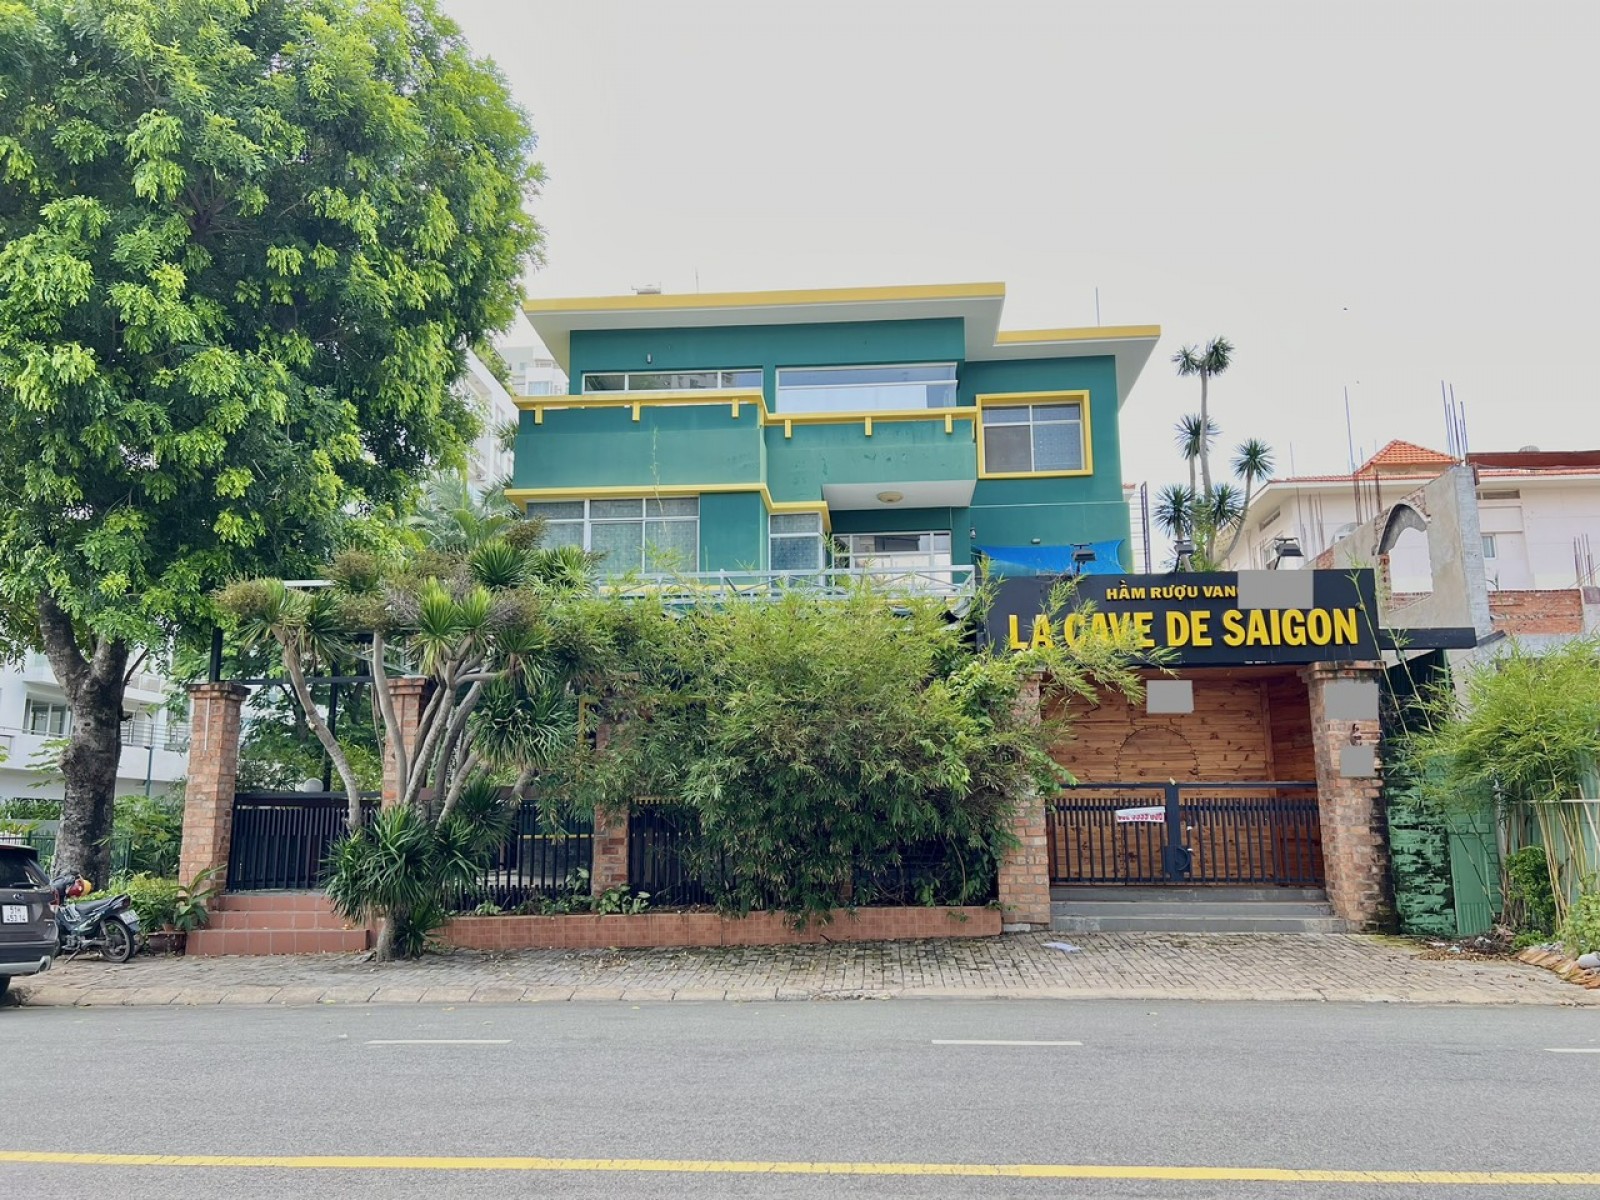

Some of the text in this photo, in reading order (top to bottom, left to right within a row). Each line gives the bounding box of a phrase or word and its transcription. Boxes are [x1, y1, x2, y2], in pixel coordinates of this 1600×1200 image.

[1106, 579, 1238, 601] HẦM RƯỢU VAN
[1008, 613, 1056, 650] LA
[1166, 610, 1213, 647] DE
[1222, 608, 1359, 647] SAIGON
